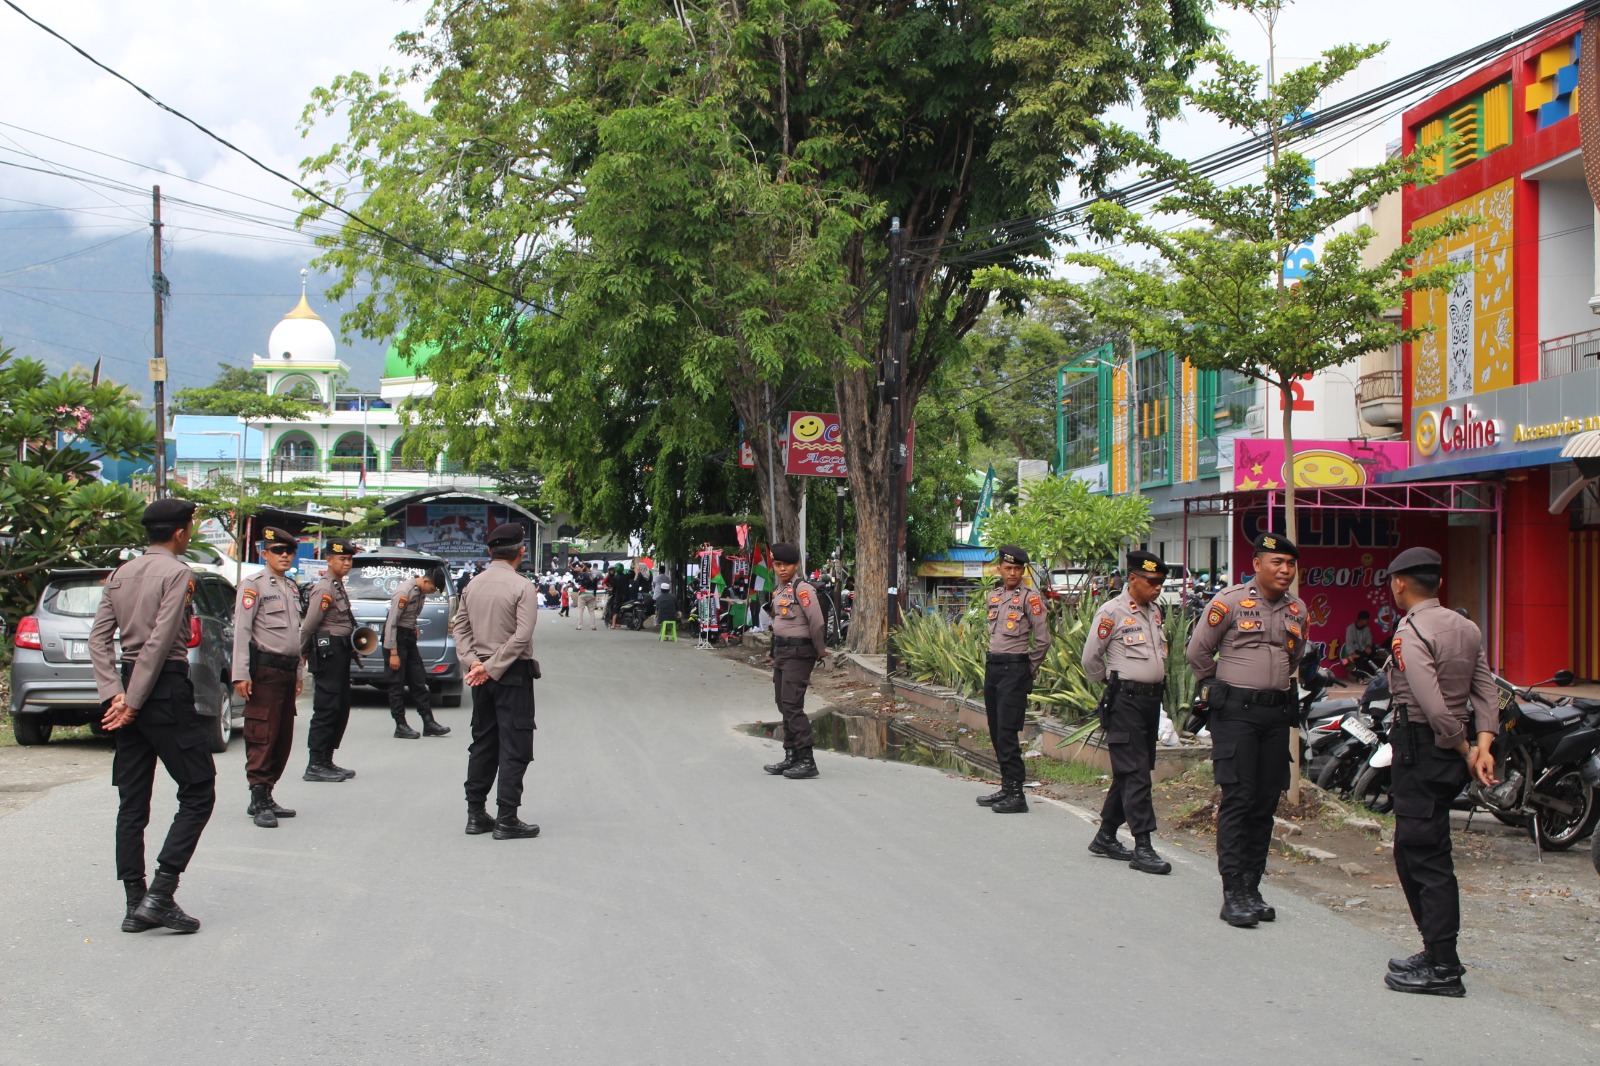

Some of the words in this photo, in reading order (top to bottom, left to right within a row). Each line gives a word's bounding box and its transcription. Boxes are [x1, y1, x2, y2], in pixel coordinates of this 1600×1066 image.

[1439, 403, 1497, 452] Celine
[1512, 417, 1582, 443] Accesories
[1241, 501, 1401, 548] CLINE
[73, 642, 85, 654] DN
